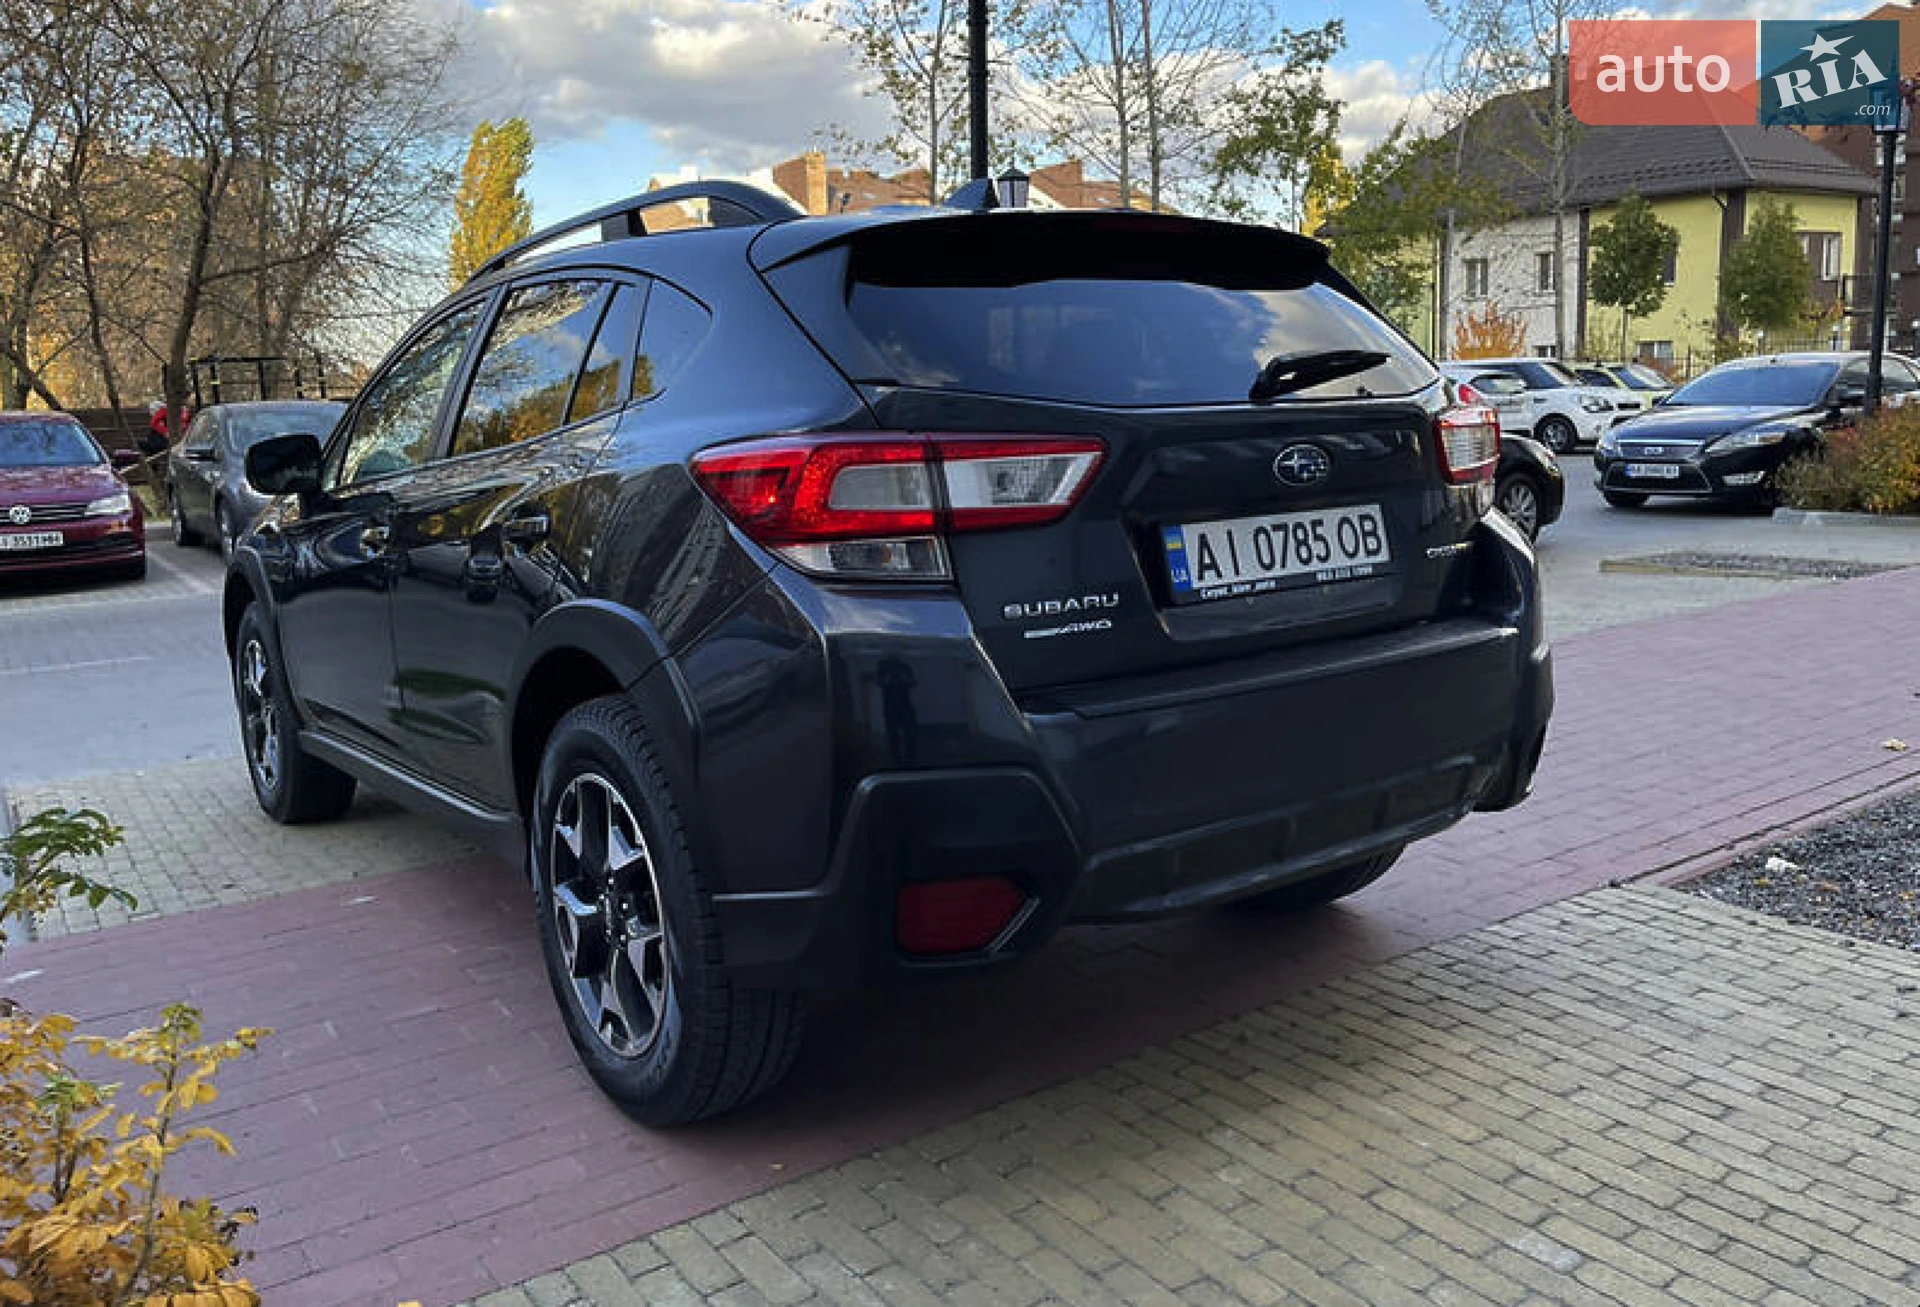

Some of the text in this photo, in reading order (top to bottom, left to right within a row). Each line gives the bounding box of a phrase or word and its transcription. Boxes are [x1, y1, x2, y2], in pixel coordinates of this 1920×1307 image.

[1198, 513, 1381, 580] AI 0785 OB
[1170, 568, 1189, 583] UA
[1004, 592, 1119, 618] SUBARU
